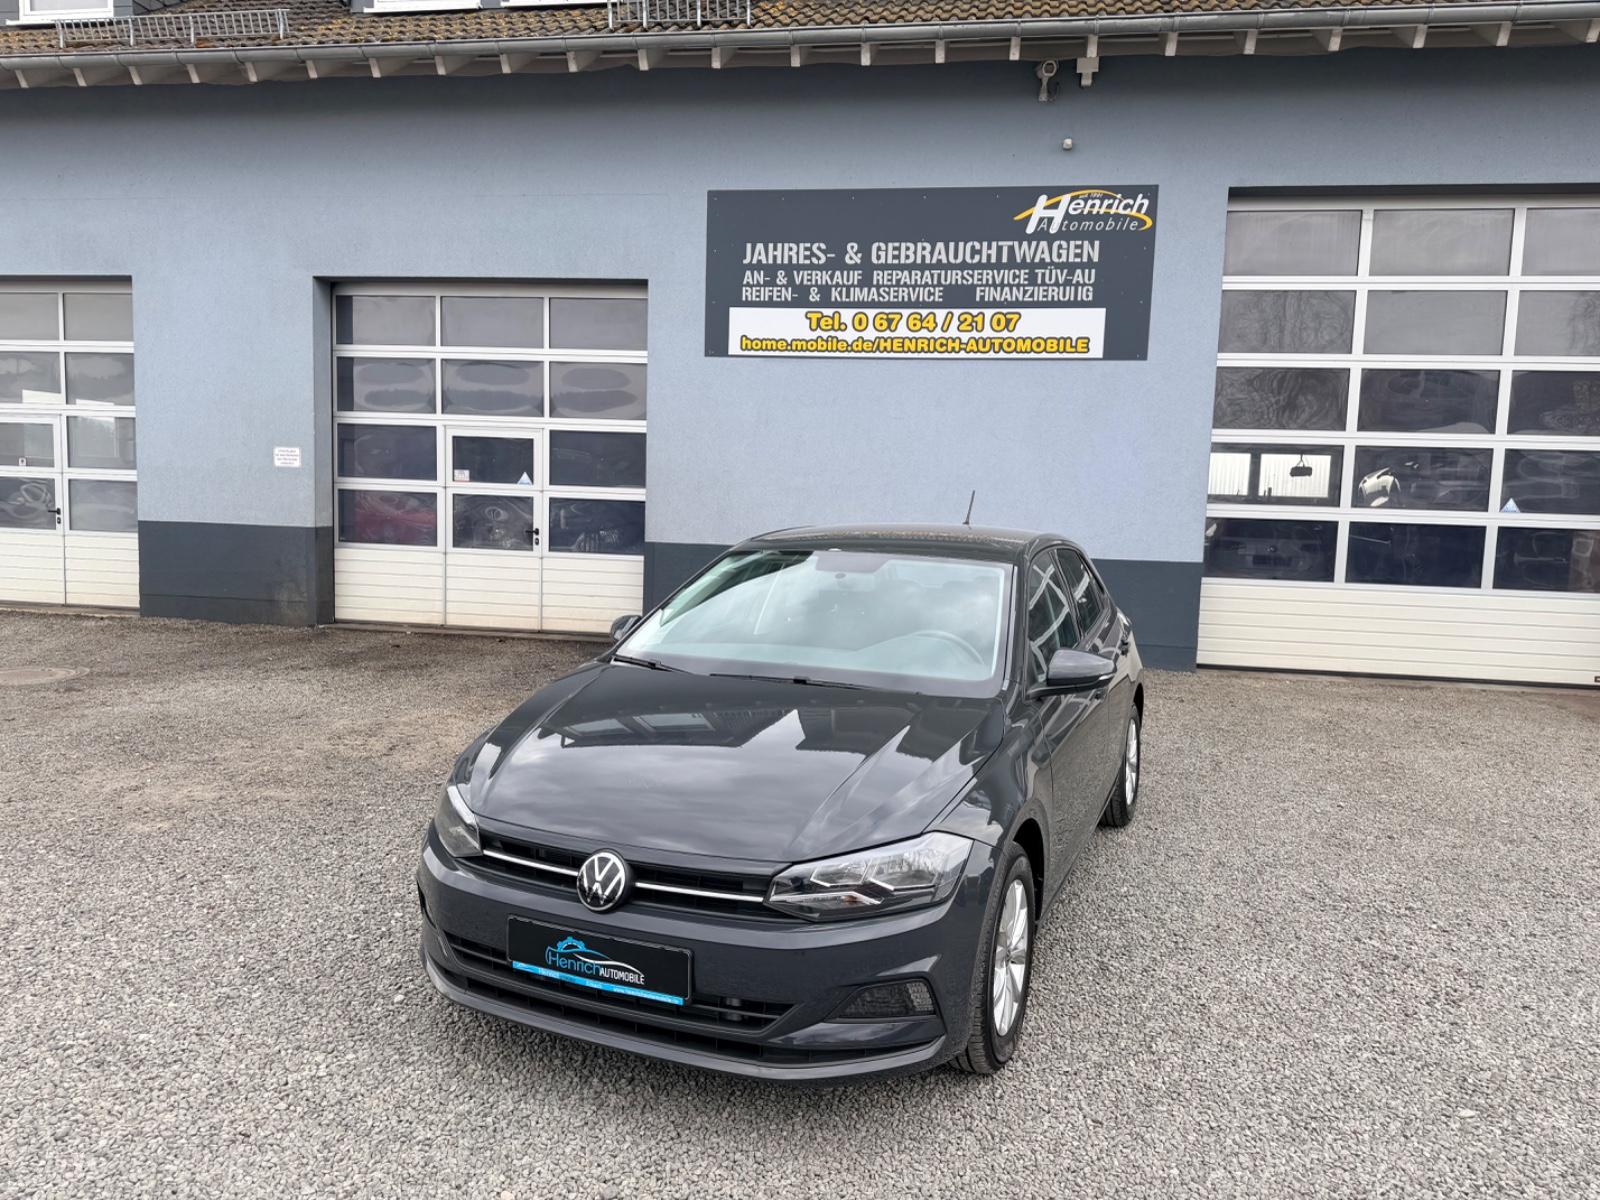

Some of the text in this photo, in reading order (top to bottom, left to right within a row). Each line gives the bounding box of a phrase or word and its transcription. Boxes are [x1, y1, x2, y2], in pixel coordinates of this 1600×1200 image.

[1025, 193, 1150, 235] Henrich
[742, 240, 1100, 265] JAHRES- & GEBRAUCHTWAGEN
[743, 266, 1096, 285] AN- & VERKAUF REPARATURSERVICE TÜV-AU
[742, 286, 798, 302] REIFEN-
[809, 286, 821, 302] &
[831, 286, 944, 302] KLIMASERVICE
[805, 311, 1021, 332] Tel. 0 67 64 / 21 07
[740, 335, 1090, 354] home.mobile.de/HENRICH-AUTOMOBILE
